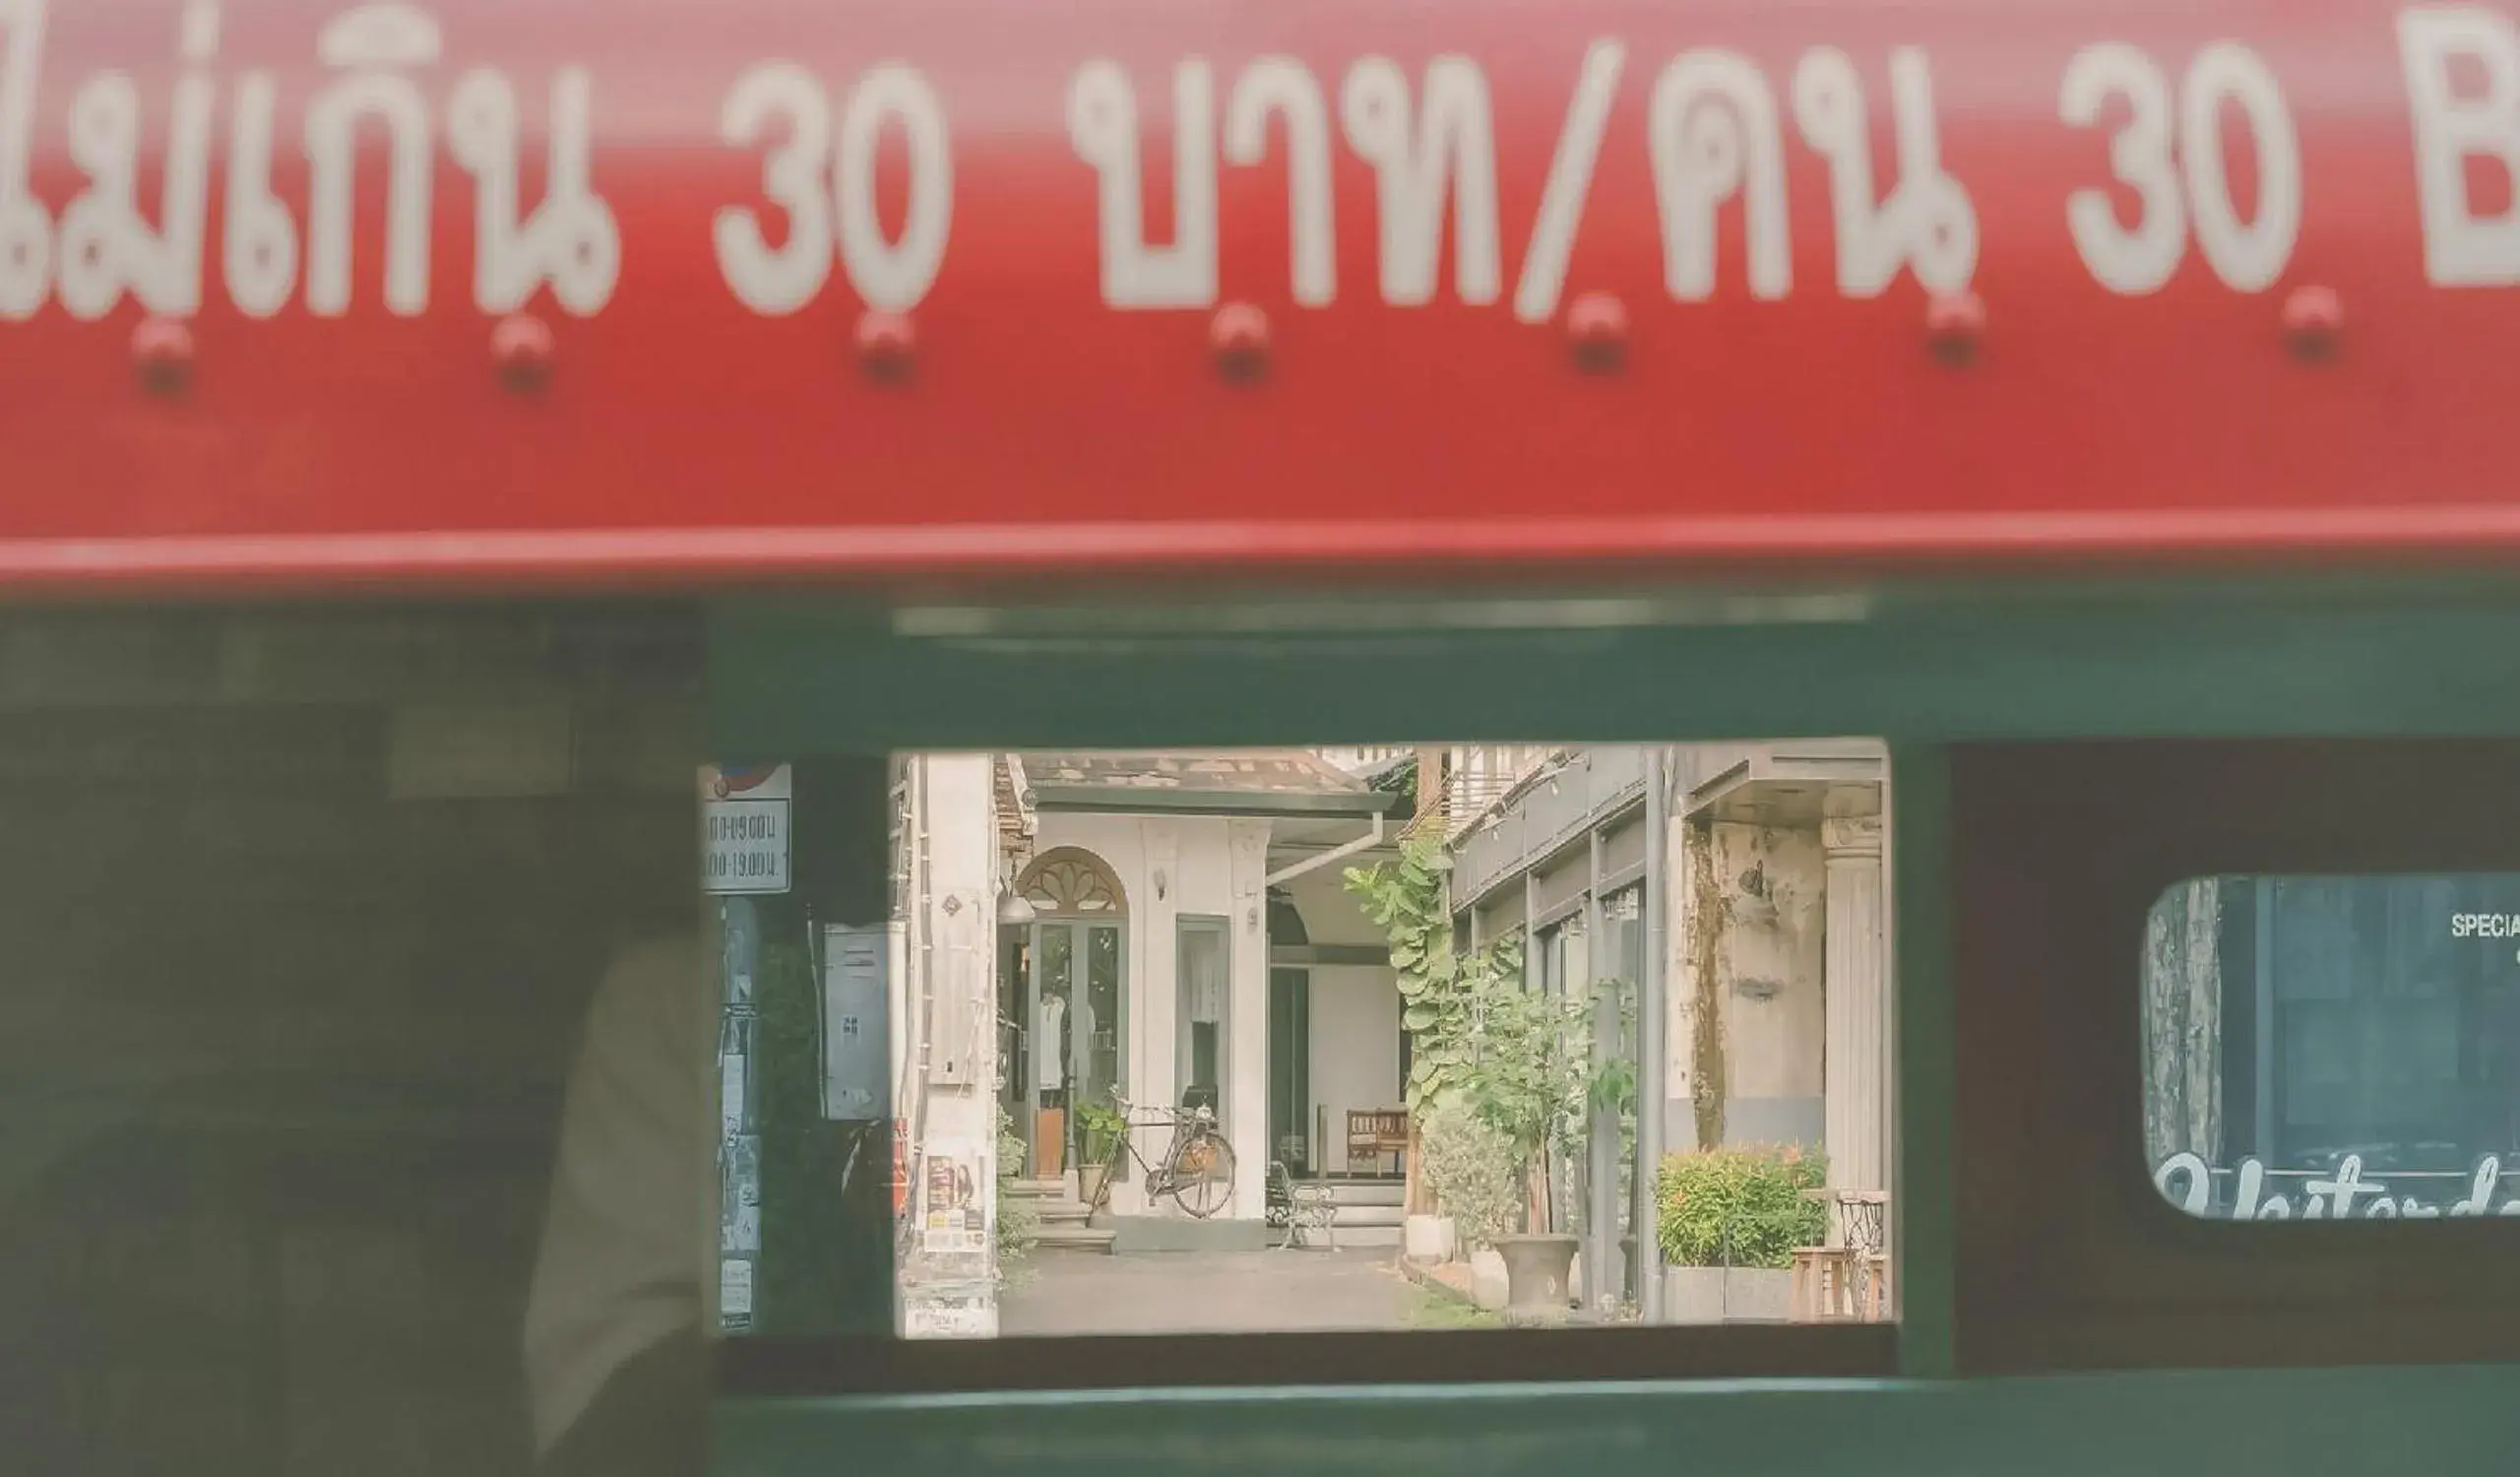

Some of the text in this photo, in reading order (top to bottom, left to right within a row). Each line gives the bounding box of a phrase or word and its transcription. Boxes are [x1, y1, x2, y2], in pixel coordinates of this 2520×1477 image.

[711, 59, 953, 317] 30
[1066, 35, 1980, 325] บาท/คน
[2058, 39, 2301, 295] 30
